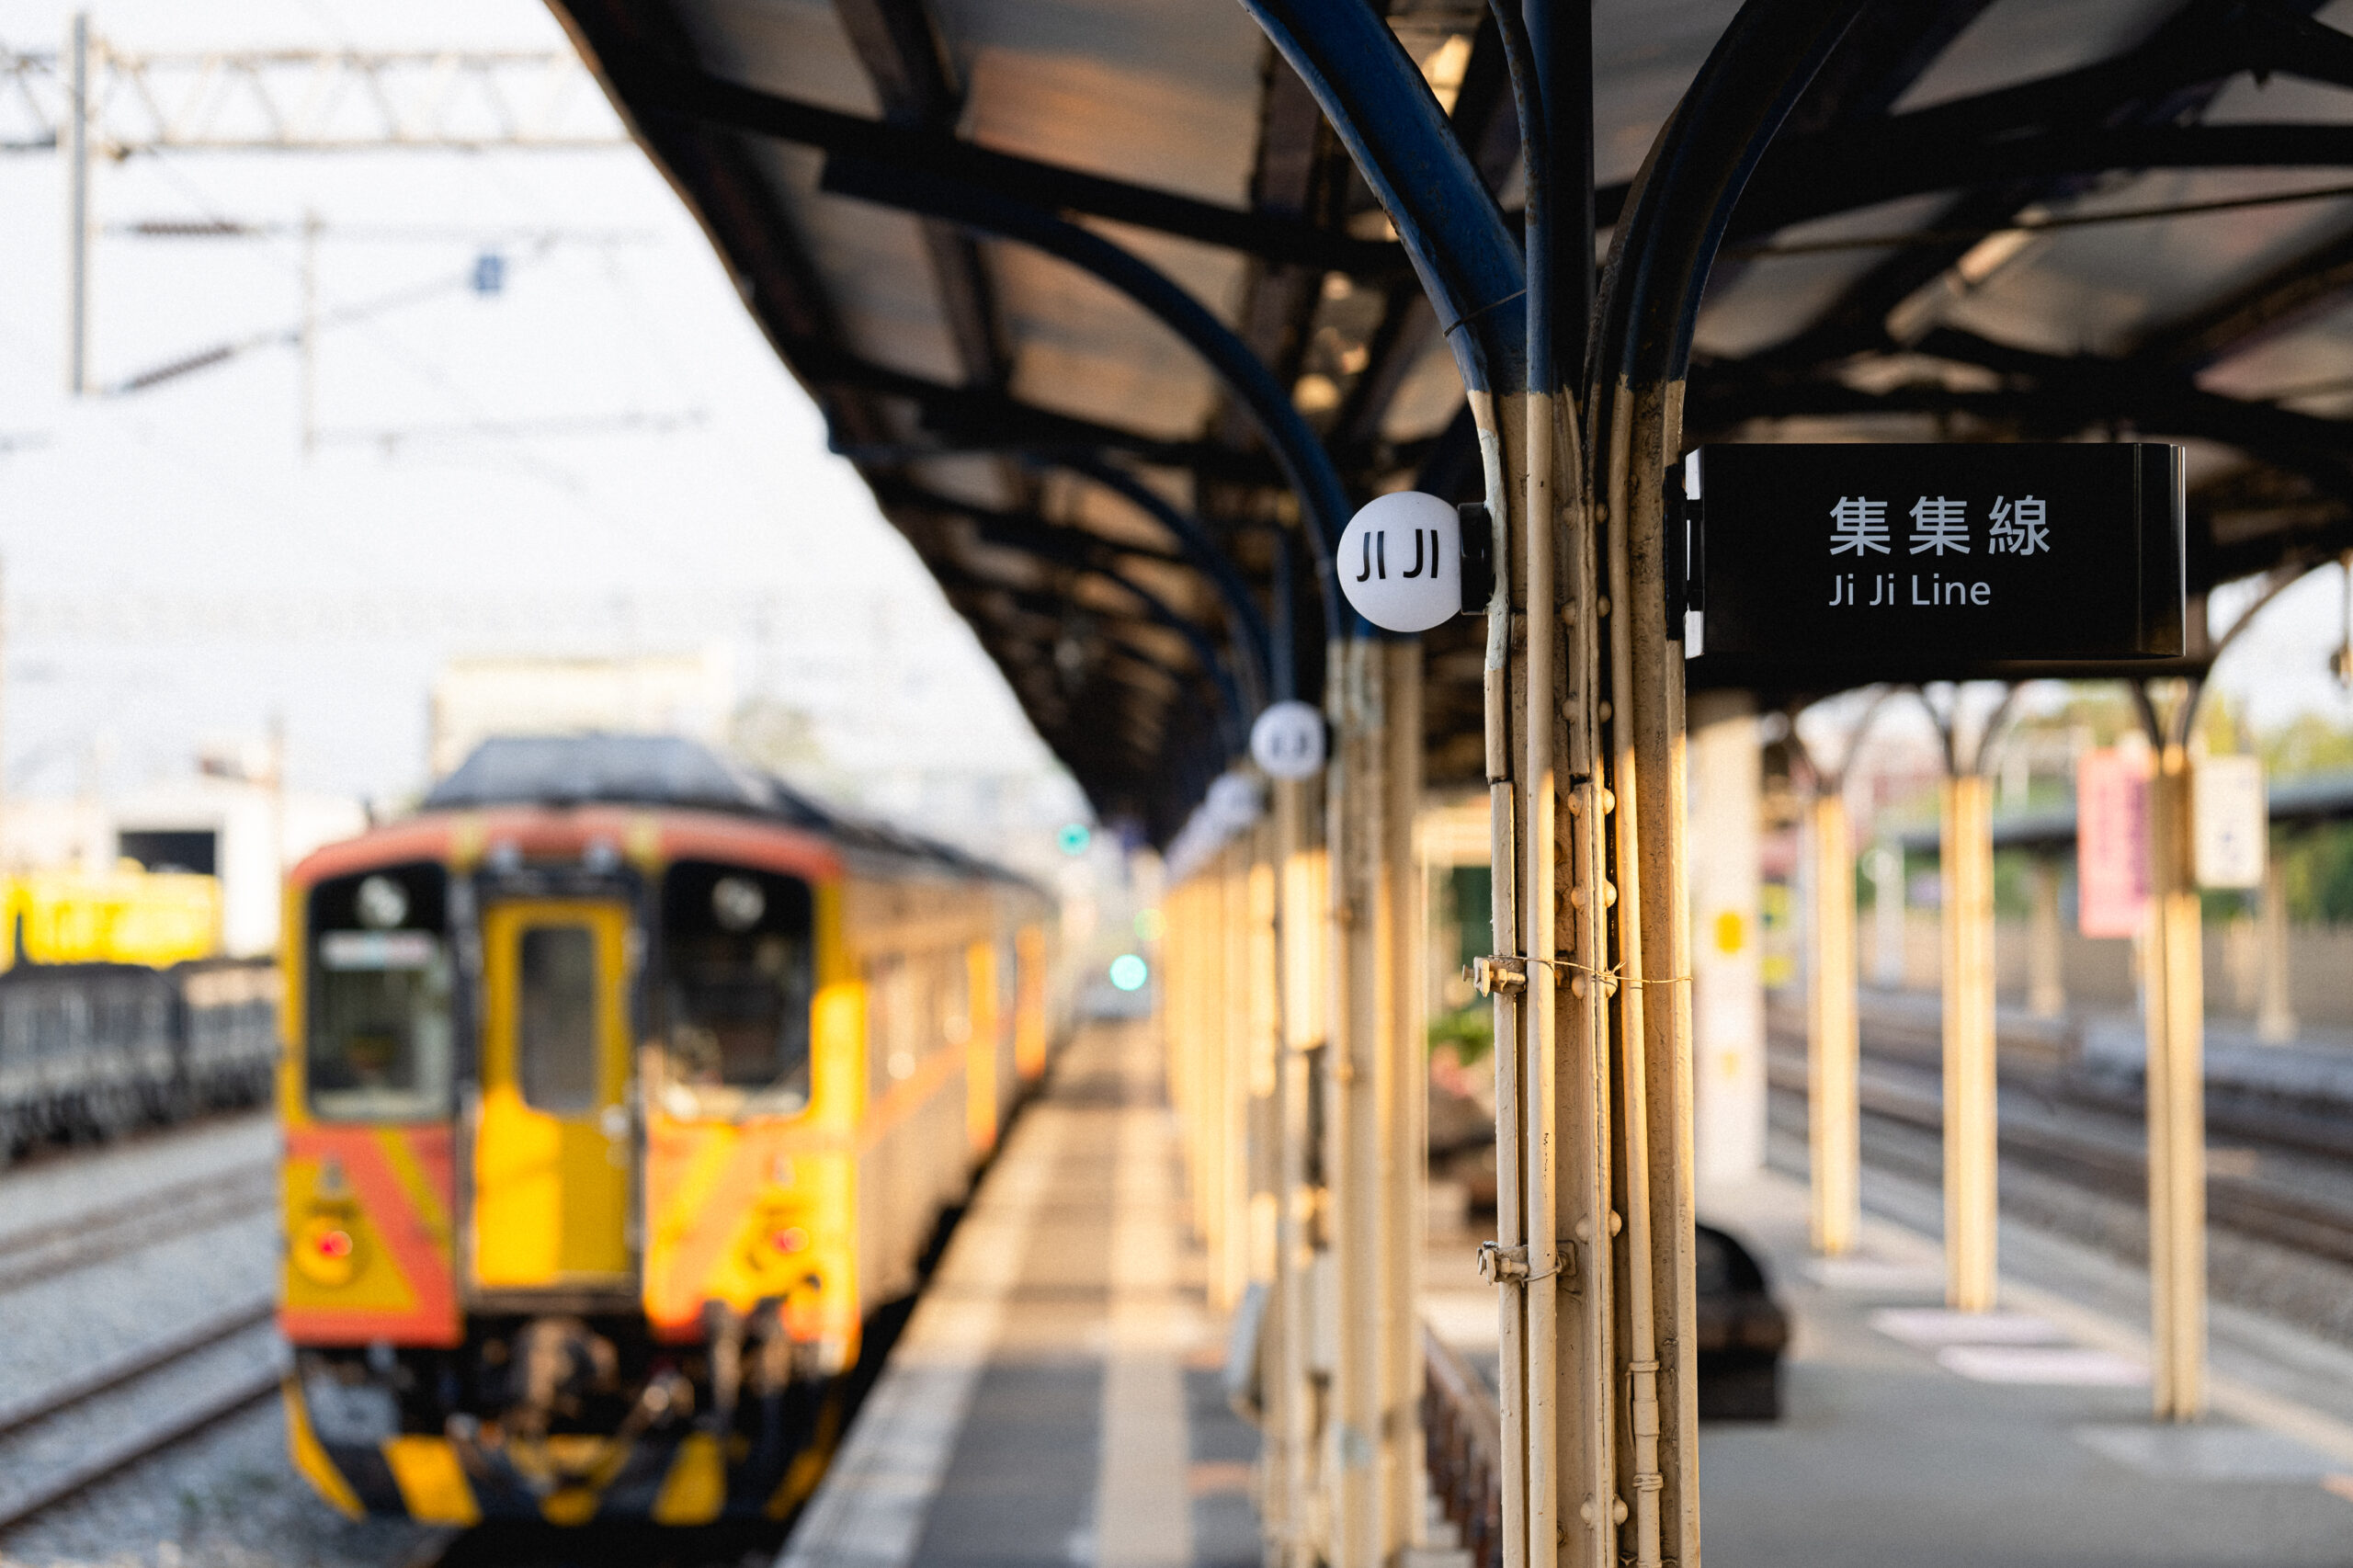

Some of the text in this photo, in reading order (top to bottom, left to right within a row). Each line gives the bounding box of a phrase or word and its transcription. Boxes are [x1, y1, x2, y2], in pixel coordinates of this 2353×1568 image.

[1829, 494, 2051, 556] 集集線
[1356, 528, 1439, 583] JI JI
[1828, 573, 1992, 607] Ji Ji Line
